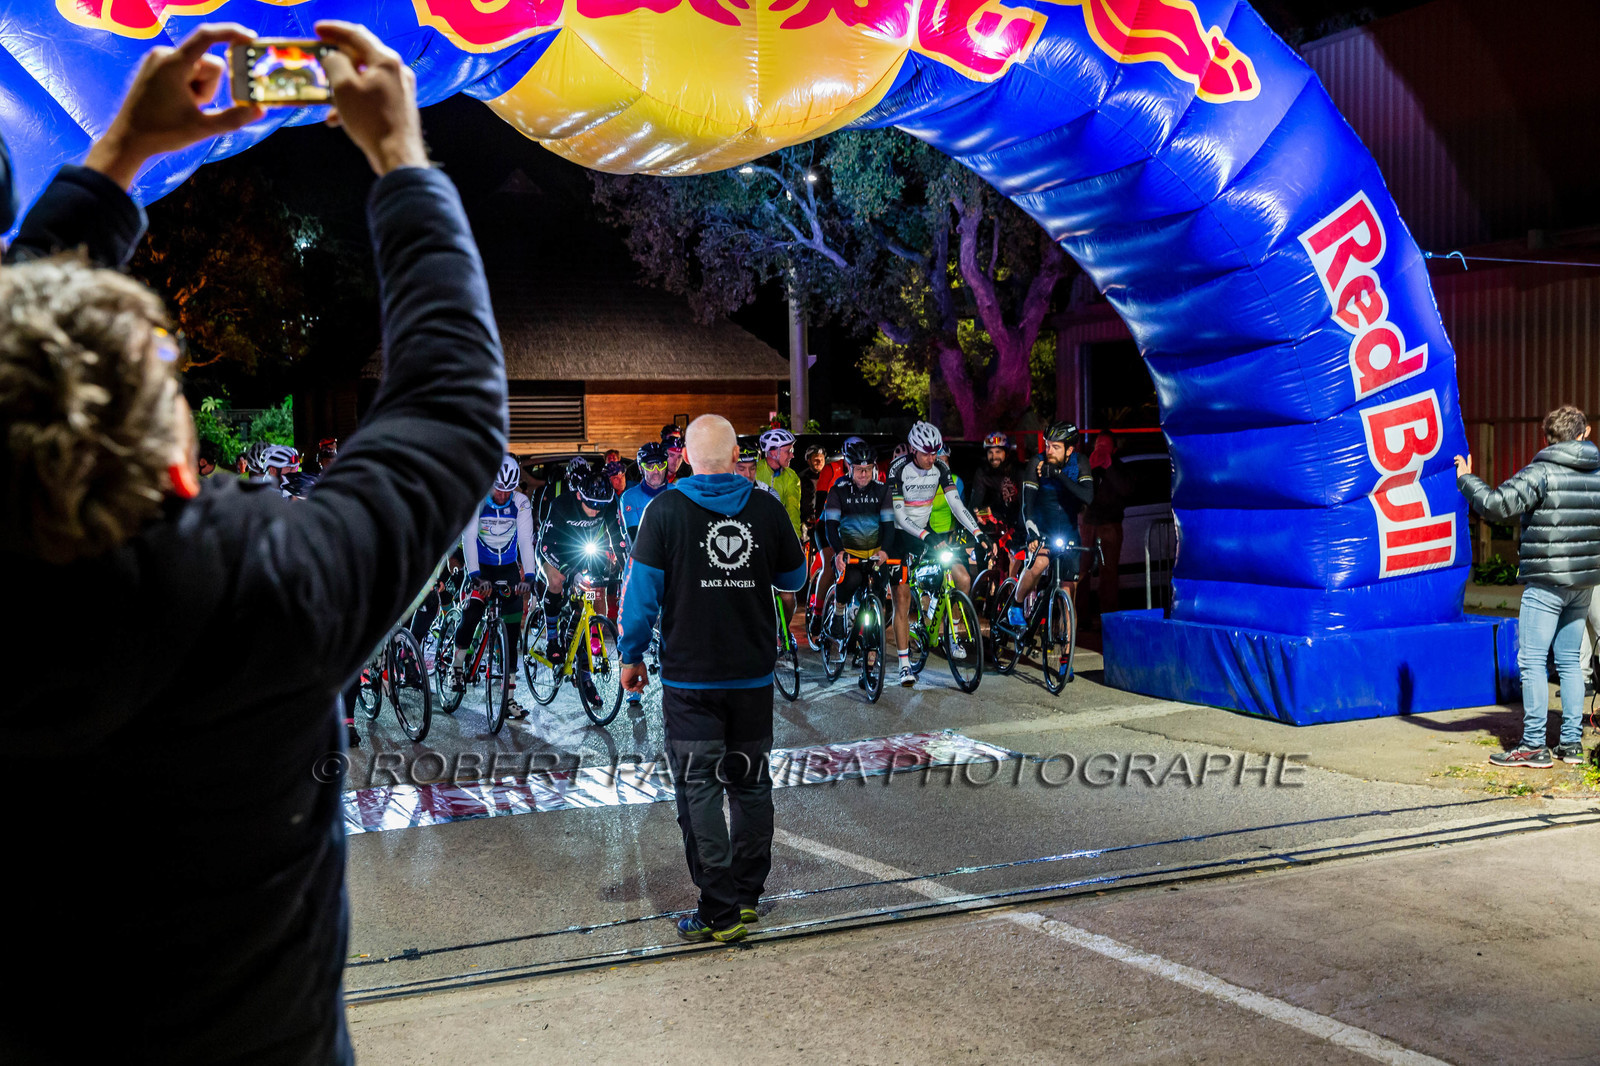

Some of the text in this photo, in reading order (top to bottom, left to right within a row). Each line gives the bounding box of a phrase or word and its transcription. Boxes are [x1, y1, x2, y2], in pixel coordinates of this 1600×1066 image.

[1303, 195, 1454, 575] Red Bull
[701, 580, 756, 588] RACE ANGELS
[586, 592, 595, 600] 28
